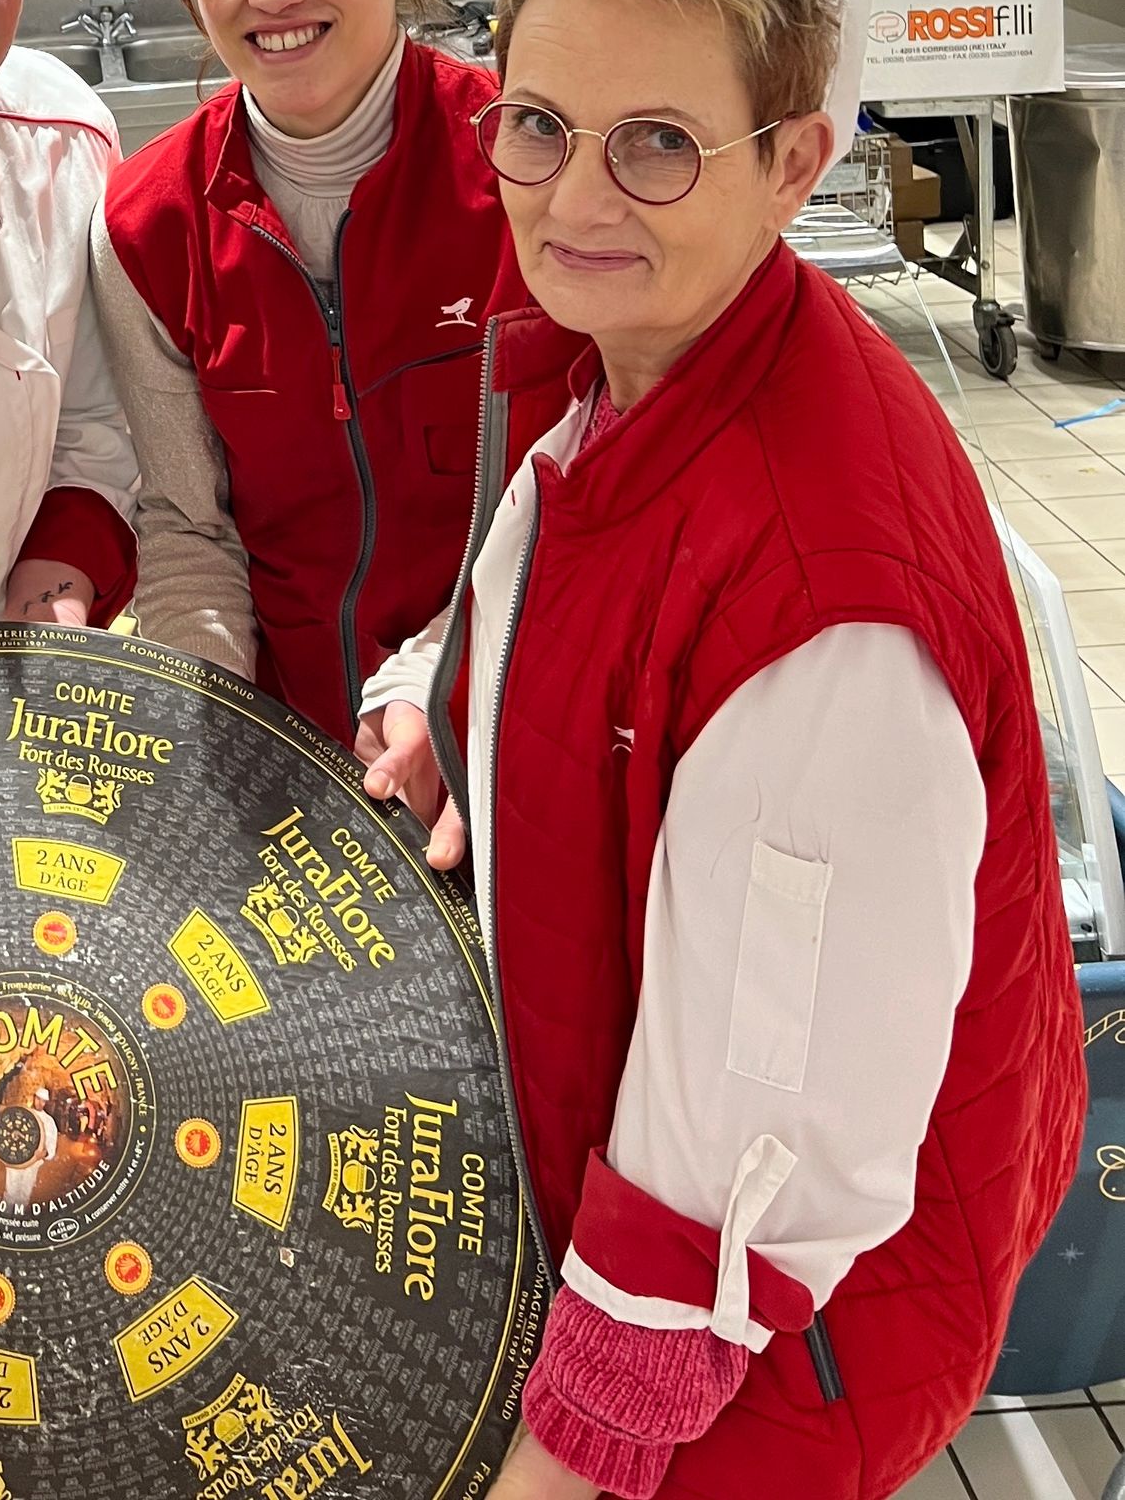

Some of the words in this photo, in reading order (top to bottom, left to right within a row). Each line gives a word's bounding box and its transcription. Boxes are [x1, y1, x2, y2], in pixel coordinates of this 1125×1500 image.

[908, 6, 994, 41] ROSSI
[40, 629, 87, 644] ARNAUD
[122, 641, 207, 678] FROMAGERIES
[208, 672, 255, 701] ARNAUD
[55, 682, 135, 714] COMTE
[6, 696, 174, 764] JuraFlore
[18, 740, 54, 766] Fort
[55, 750, 84, 771] des
[87, 756, 155, 786] Rousses
[36, 849, 48, 865] 2
[51, 853, 97, 875] ANS
[39, 870, 89, 893] D'ÂGE
[330, 827, 397, 905] COMTE
[257, 843, 290, 881] Fort
[282, 873, 311, 909] des
[304, 901, 358, 973] Rousses
[260, 805, 396, 969] JuraFlore
[187, 953, 226, 1001] D'ÂGE
[197, 933, 215, 952] 2
[209, 947, 247, 993] ANS
[268, 1123, 288, 1138] 2
[381, 1104, 407, 1146] Fort
[244, 1125, 263, 1185] D'ÂGE
[263, 1144, 286, 1196] ANS
[378, 1147, 405, 1185] des
[14, 1206, 25, 1216] M
[32, 1159, 111, 1216] D'ALTITUDE
[403, 1090, 458, 1301] JuraFlore
[457, 1152, 485, 1256] COMTE
[374, 1188, 403, 1275] Rousses
[137, 1299, 188, 1347] D'ÂGE
[190, 1312, 211, 1337] 2
[147, 1331, 193, 1374] ANS
[282, 1403, 324, 1444] Fort
[249, 1430, 282, 1466] des
